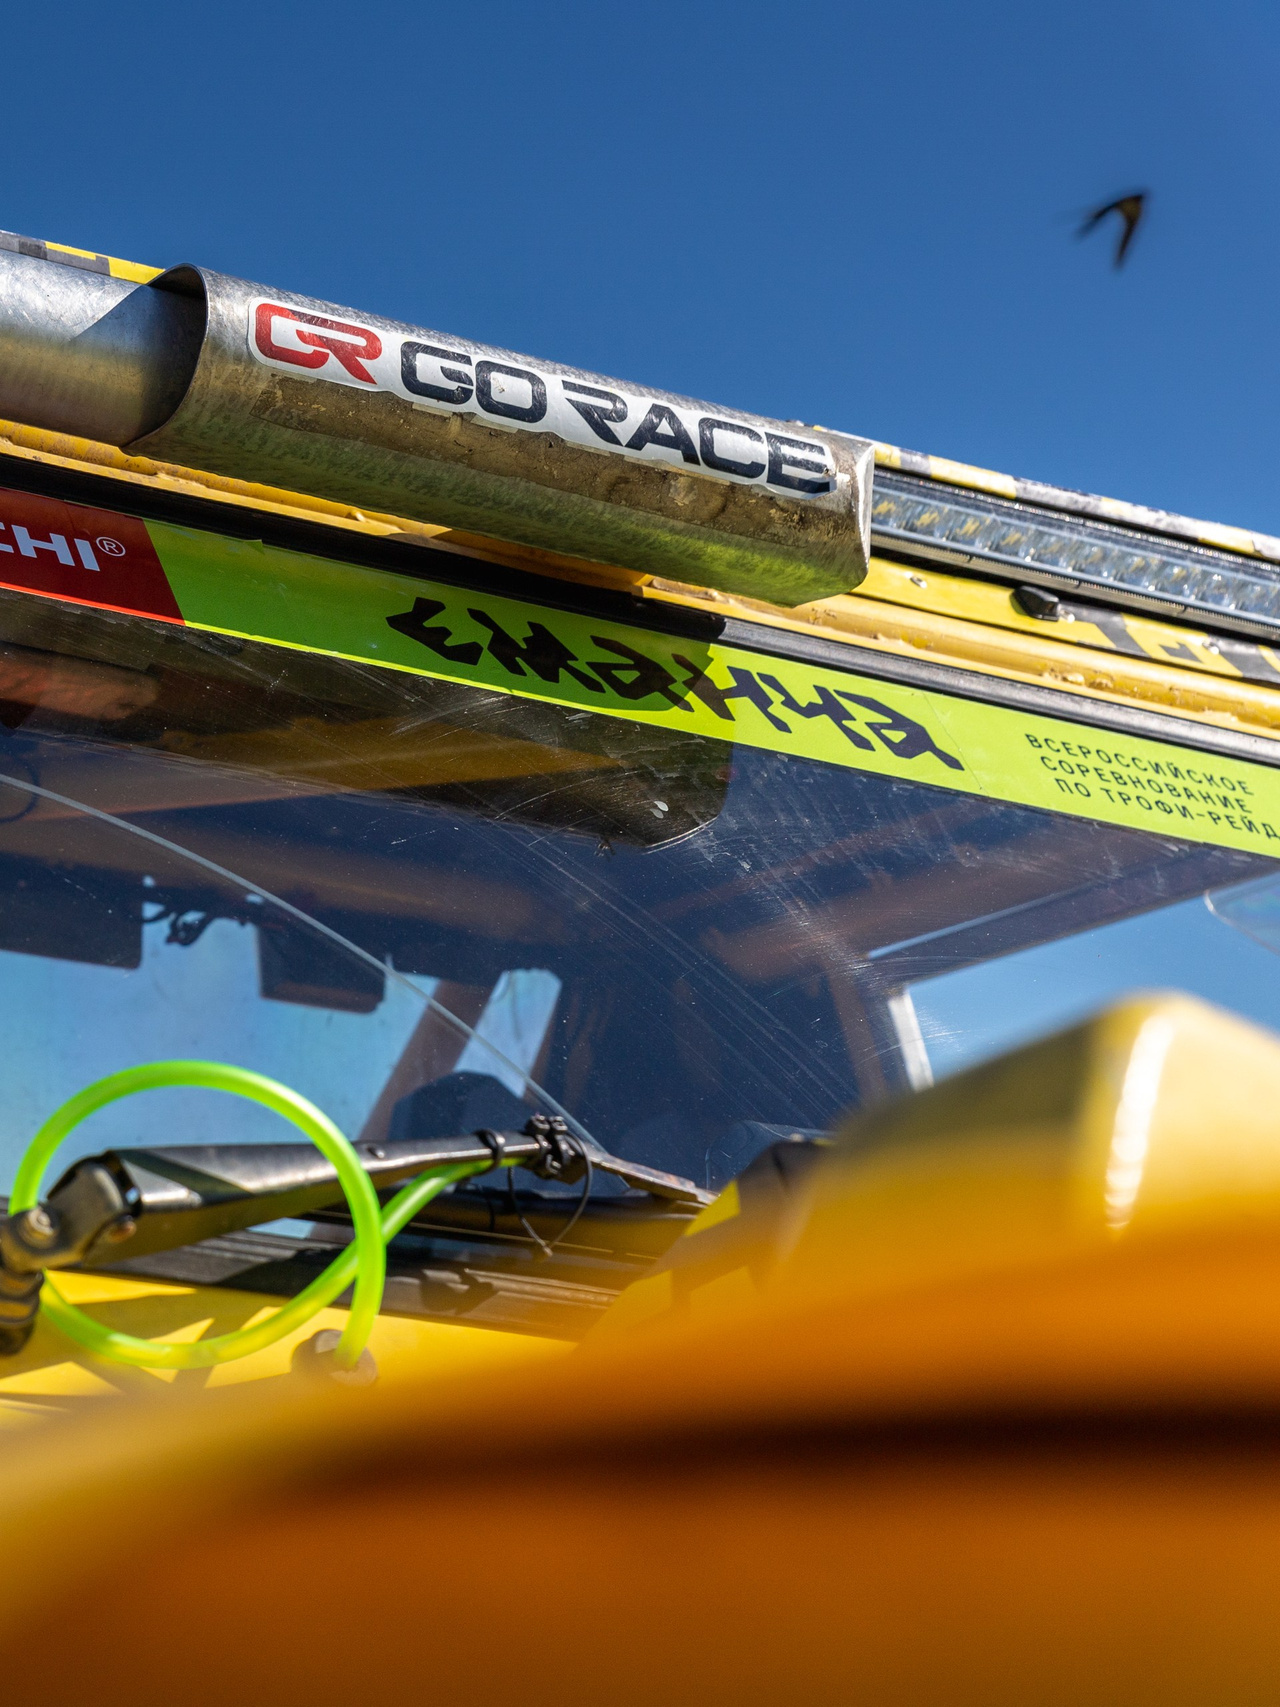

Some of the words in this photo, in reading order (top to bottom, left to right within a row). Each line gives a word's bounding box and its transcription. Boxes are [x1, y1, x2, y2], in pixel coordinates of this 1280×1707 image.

[400, 340, 548, 424] GO
[561, 379, 832, 494] RACE
[1024, 733, 1255, 796] ВСЕРОССИЙСКОЕ
[1040, 755, 1253, 814] СОРЕВНОВАНИЕ
[1054, 777, 1092, 798] ПО
